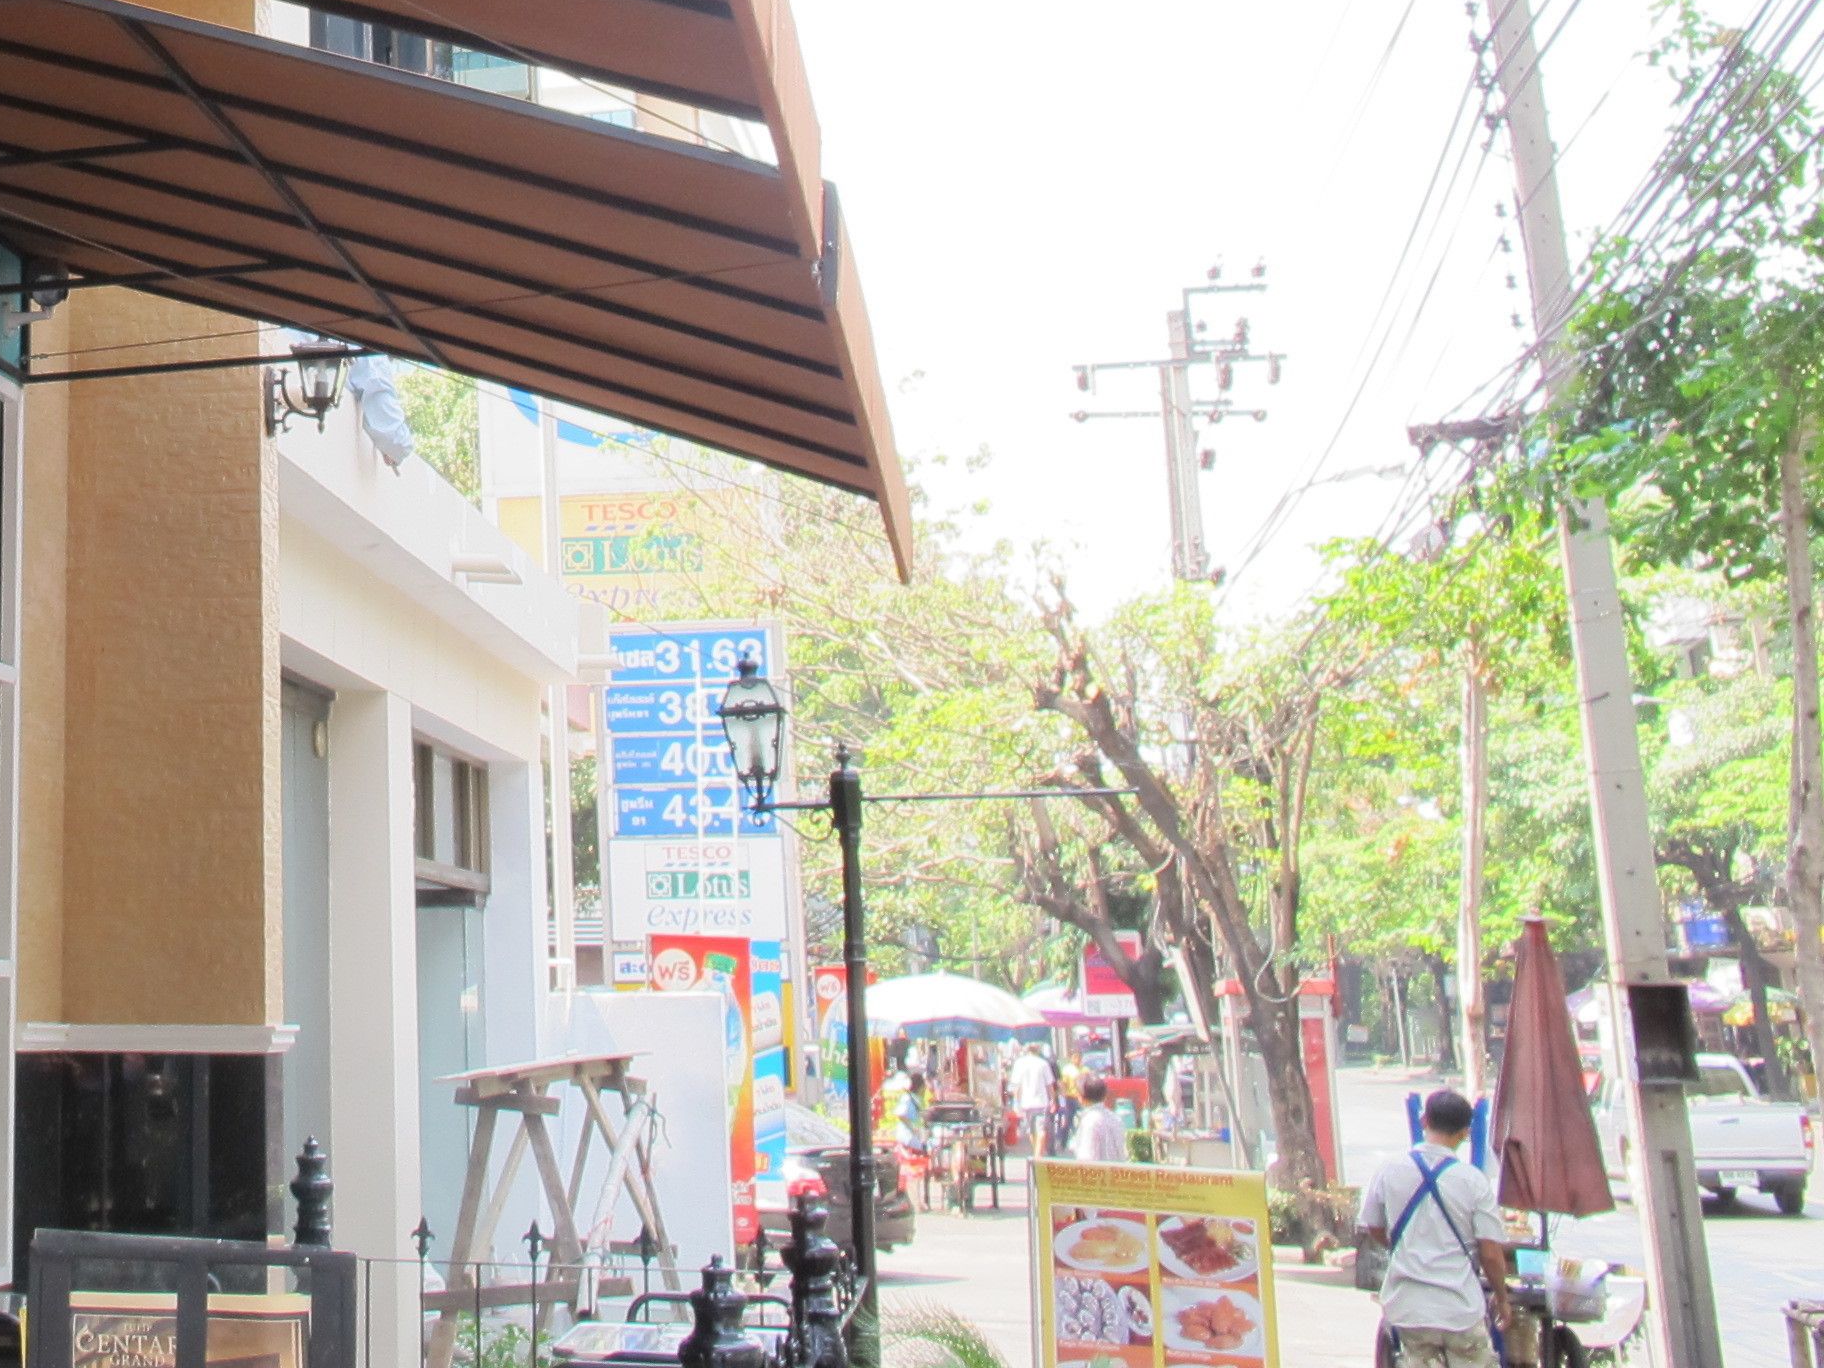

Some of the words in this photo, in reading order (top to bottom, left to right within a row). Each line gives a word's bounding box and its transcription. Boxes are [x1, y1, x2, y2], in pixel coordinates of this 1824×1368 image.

[580, 501, 679, 522] TESCO
[656, 639, 763, 674] 31.63
[662, 846, 732, 860] TESCO
[676, 871, 750, 899] Lotus
[647, 904, 752, 932] express
[111, 1354, 165, 1367] GRAND
